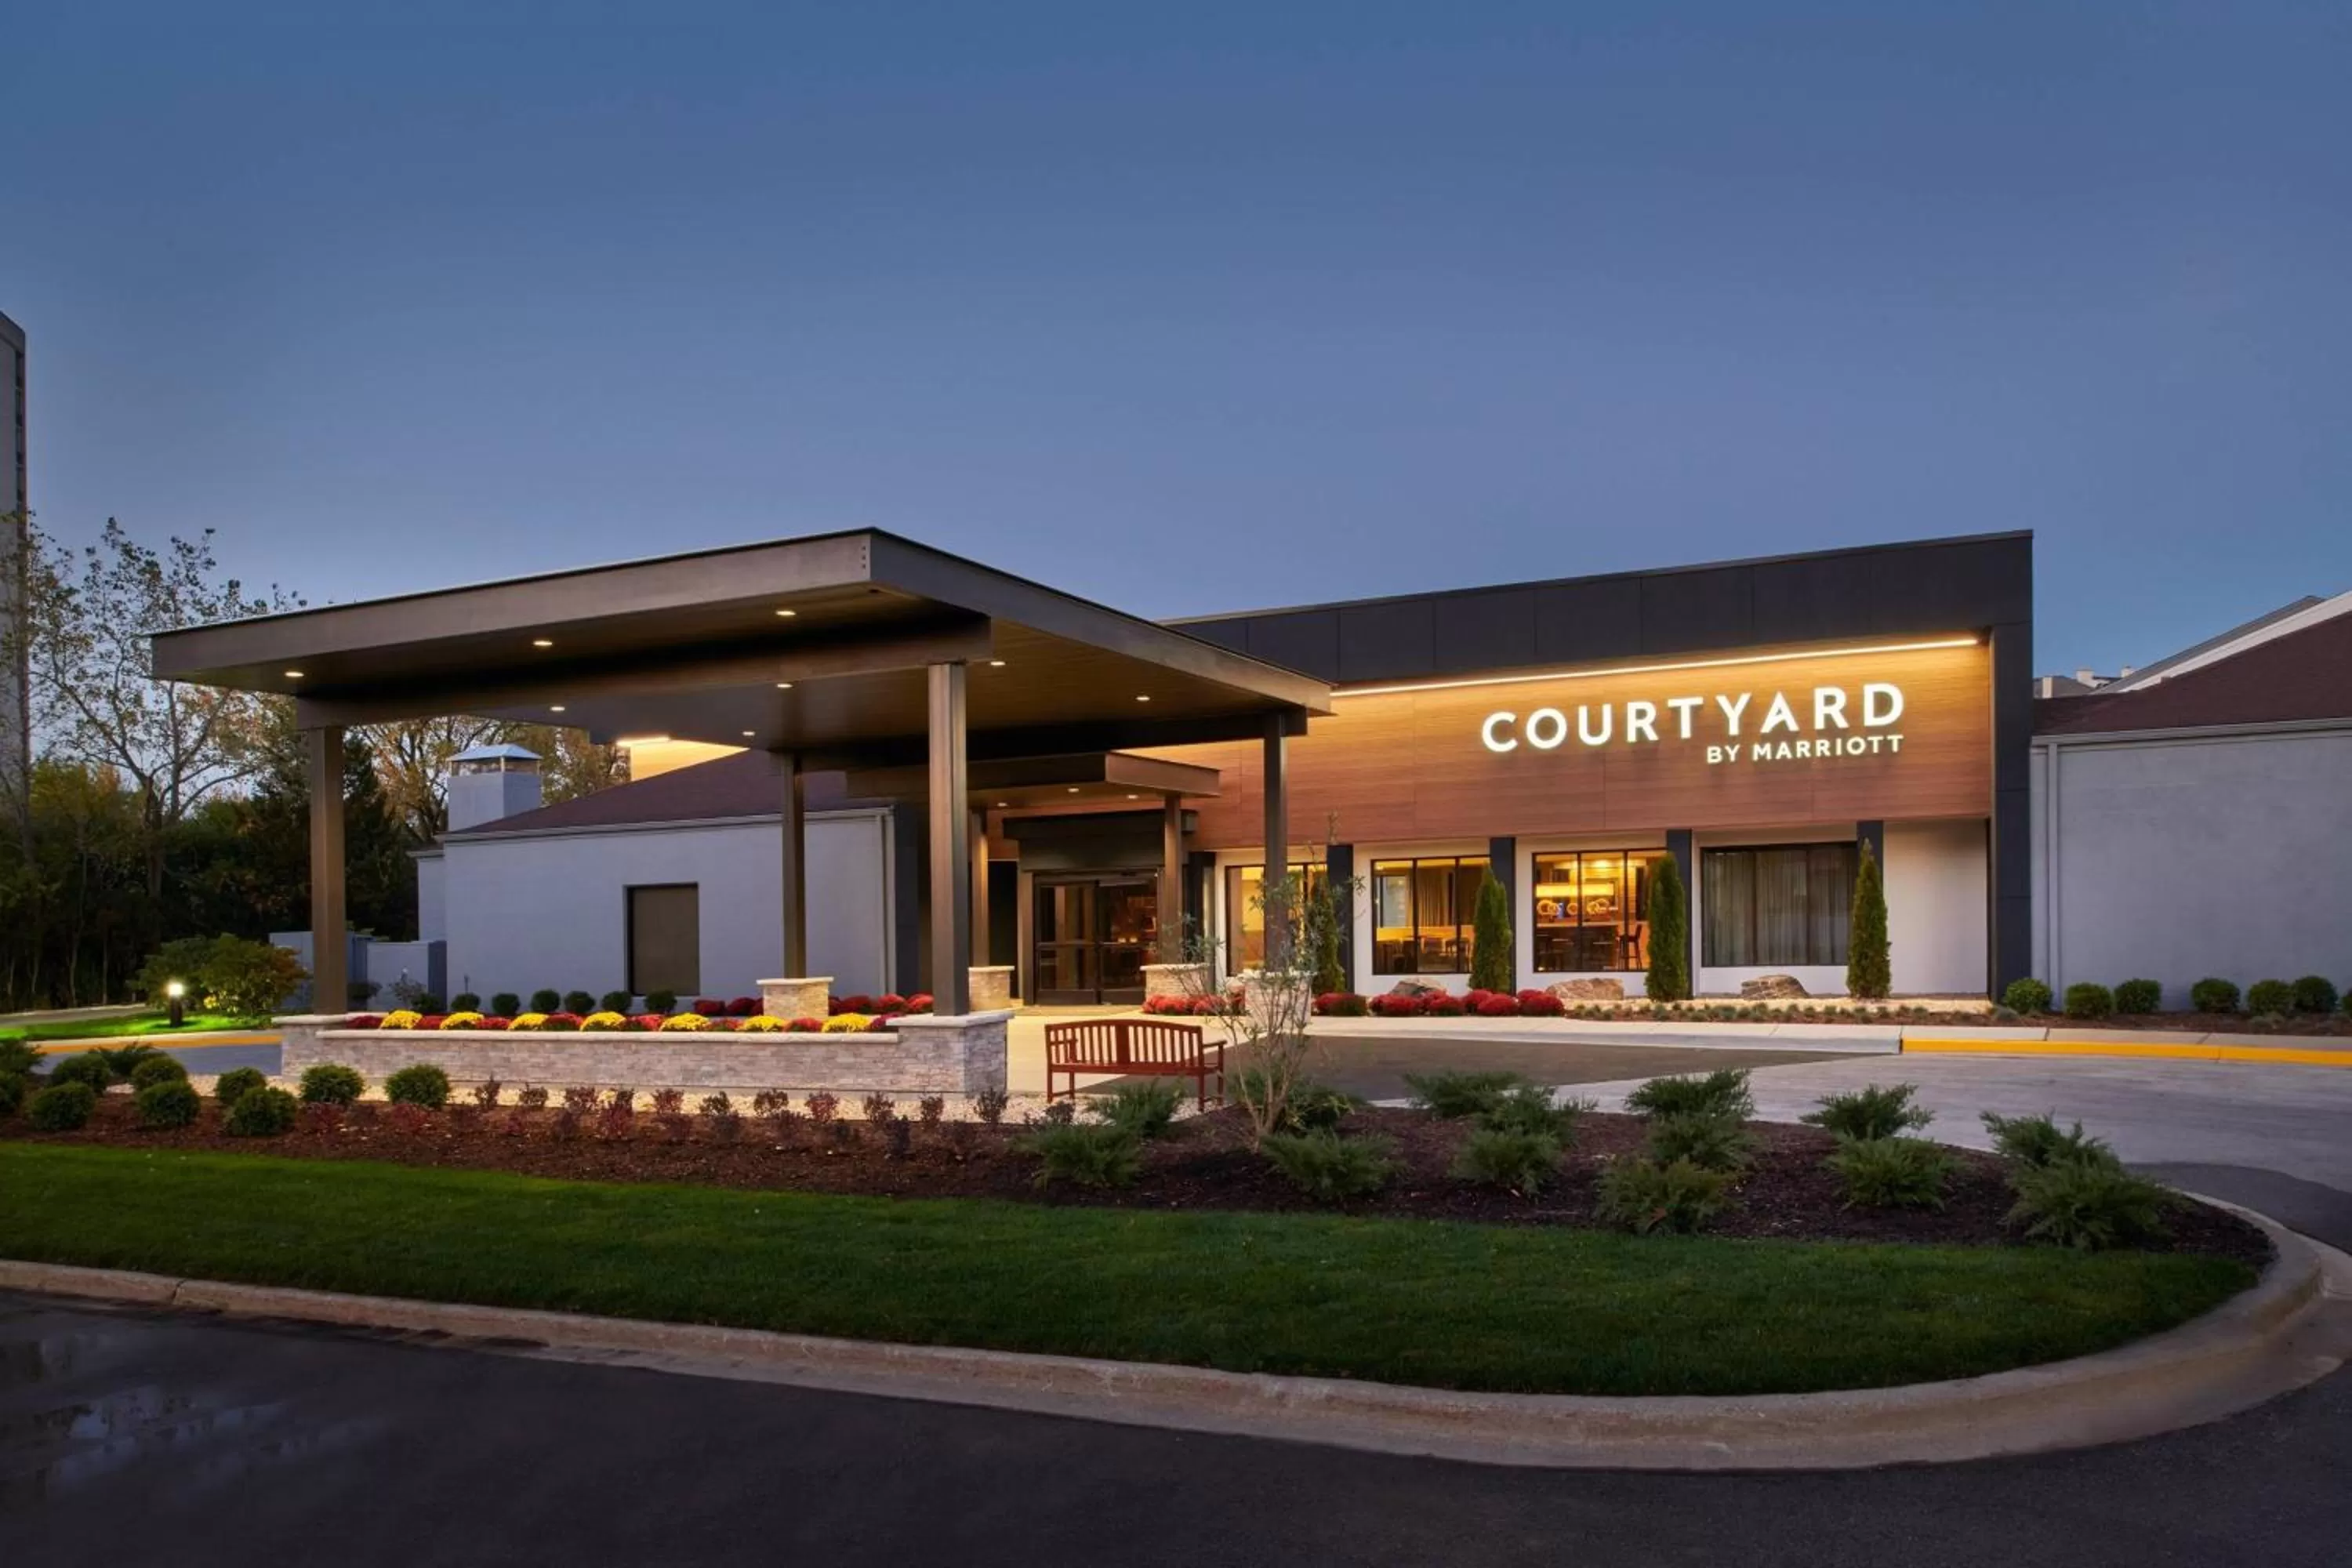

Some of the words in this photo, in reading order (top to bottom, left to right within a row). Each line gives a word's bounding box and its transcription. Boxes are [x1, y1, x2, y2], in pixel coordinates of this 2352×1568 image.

[1481, 682, 1904, 753] COURTYARD
[1706, 745, 1740, 764] BY
[1752, 735, 1904, 761] MARRIOTT
